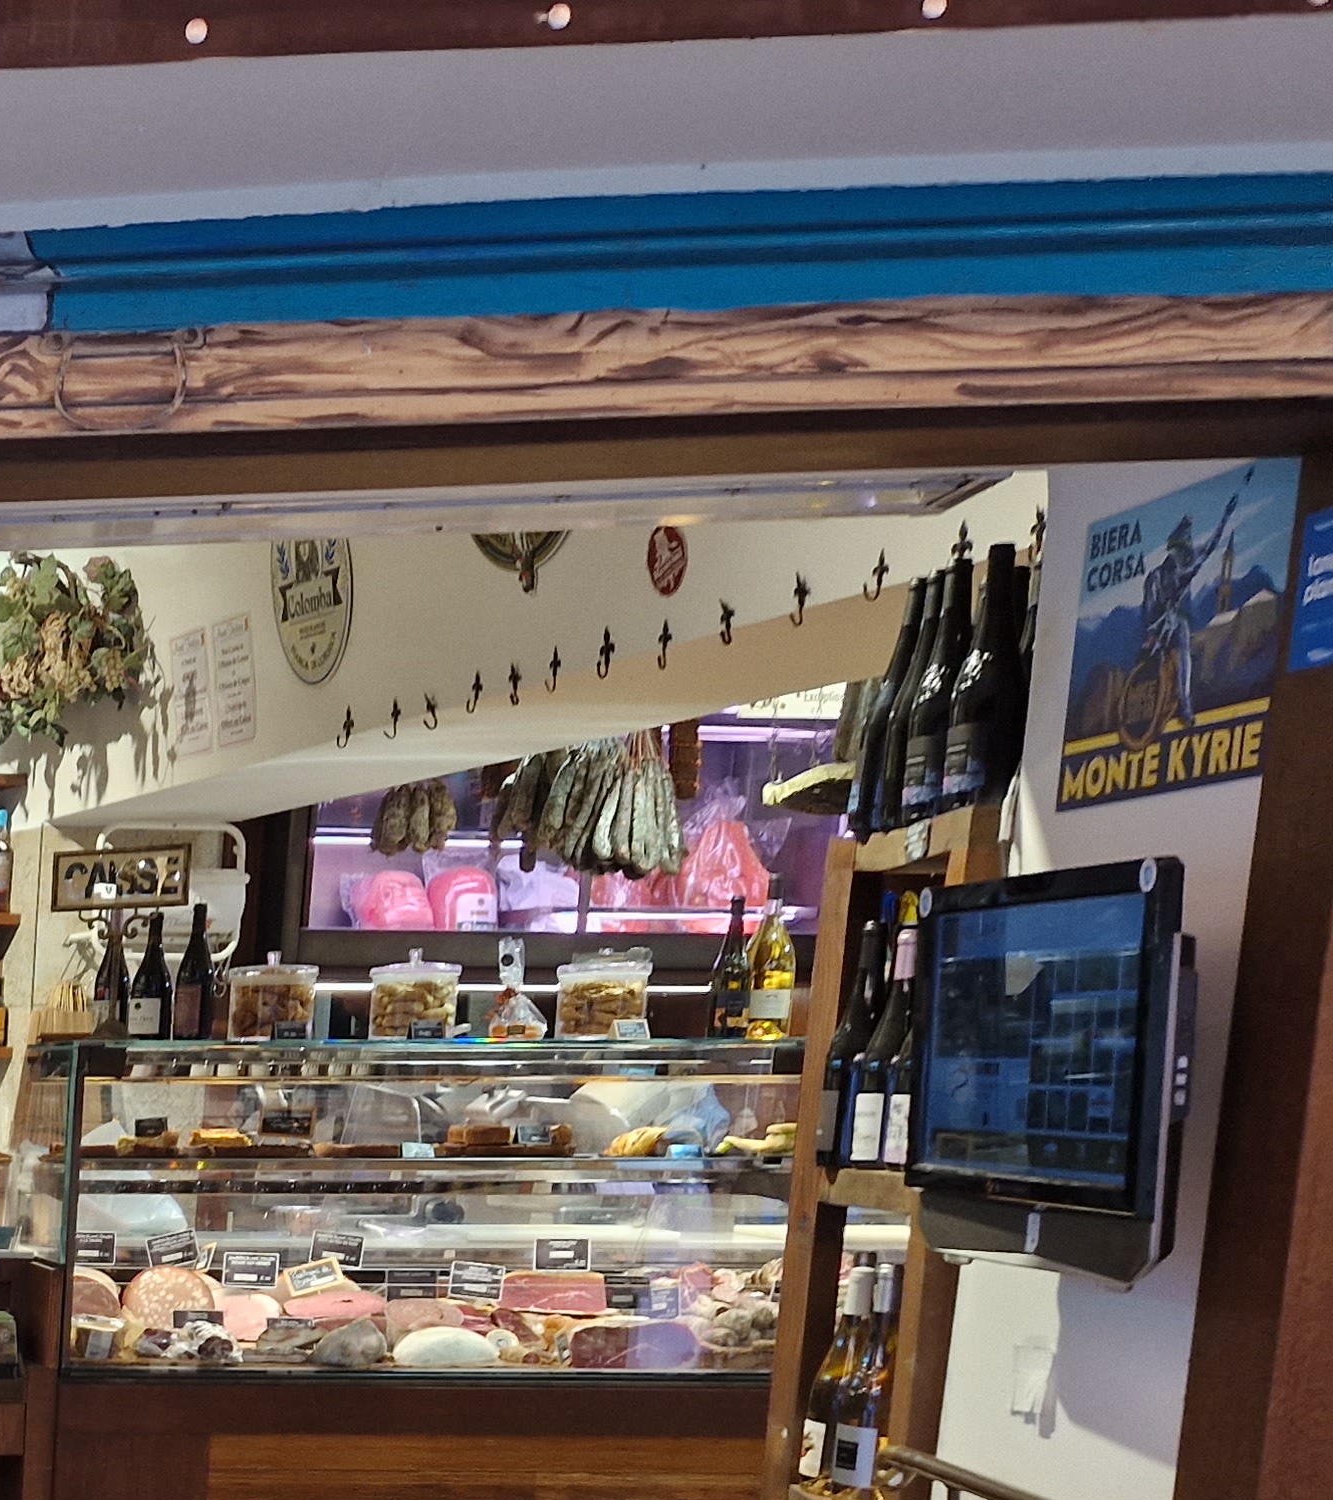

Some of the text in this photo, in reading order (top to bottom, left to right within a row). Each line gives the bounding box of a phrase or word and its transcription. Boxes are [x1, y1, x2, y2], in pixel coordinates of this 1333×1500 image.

[1091, 520, 1142, 560] BIERA
[1087, 554, 1145, 592] CORSA
[287, 586, 332, 619] Colomba
[1062, 722, 1264, 802] MONTE KYRIE
